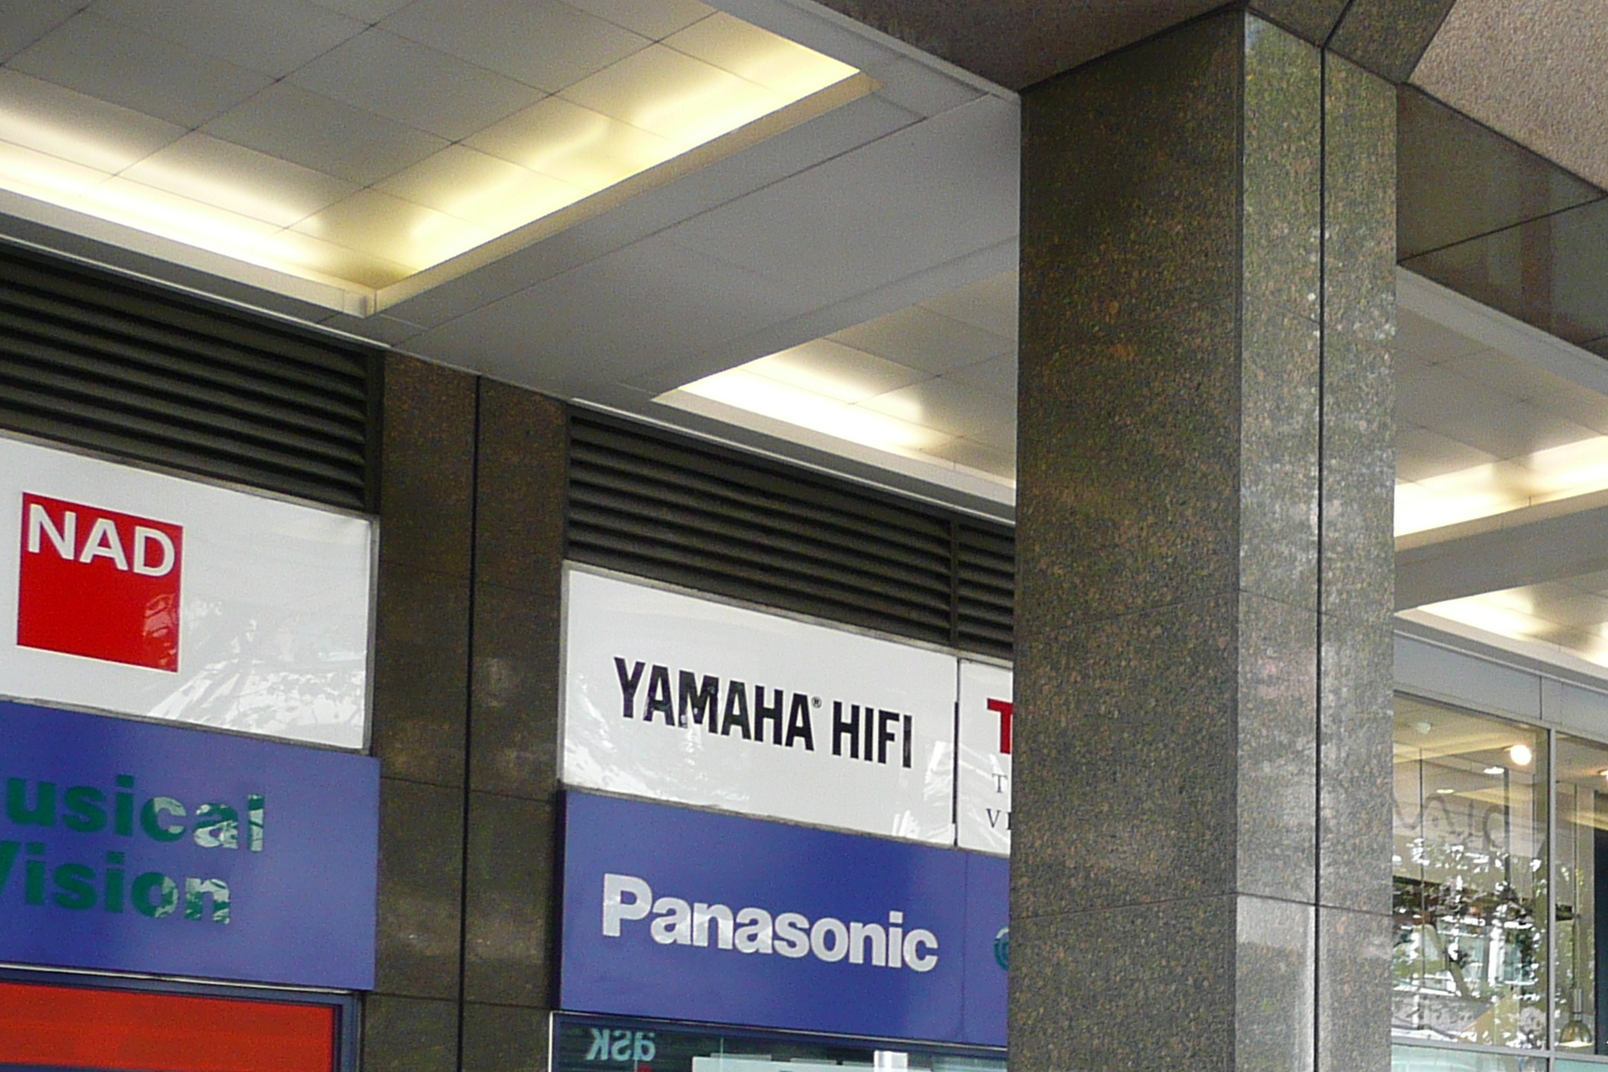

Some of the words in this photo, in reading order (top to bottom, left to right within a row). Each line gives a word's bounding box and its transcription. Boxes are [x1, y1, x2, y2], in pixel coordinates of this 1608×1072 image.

[28, 503, 176, 577] NAD
[832, 701, 912, 768] HIFI
[602, 873, 938, 972] Panasonic
